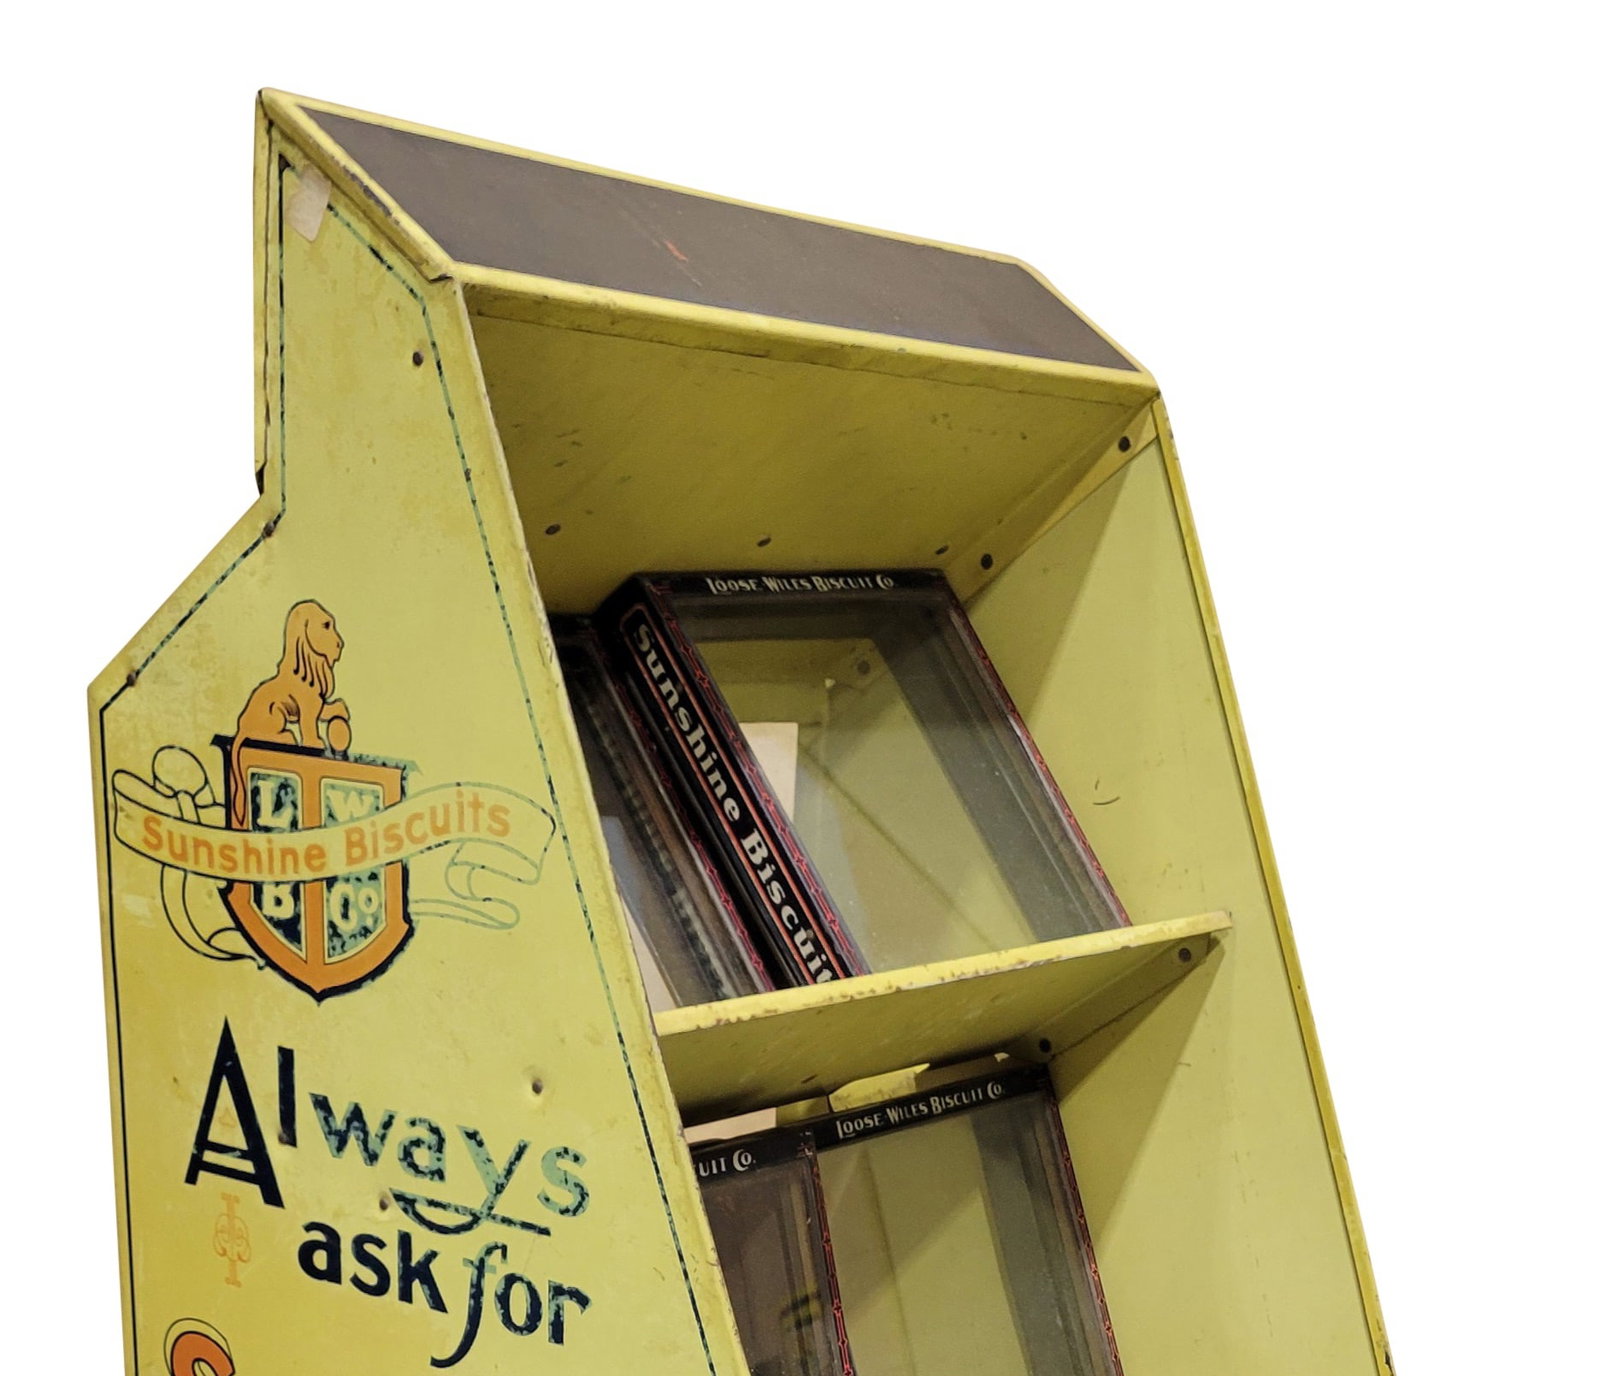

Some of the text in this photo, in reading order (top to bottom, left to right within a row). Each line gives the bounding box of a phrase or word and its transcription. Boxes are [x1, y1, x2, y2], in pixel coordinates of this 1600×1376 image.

[811, 576, 874, 592] BISCUIT
[142, 790, 511, 873] Sunshine Biscuits
[633, 623, 834, 984] Sunshine Biscuit
[184, 1015, 591, 1237] Always
[835, 1112, 883, 1139] LOOSE
[885, 1104, 929, 1125] WILES
[930, 1088, 984, 1115] BISCUIT
[697, 1156, 727, 1177] UIT
[298, 1220, 592, 1369] ask for
